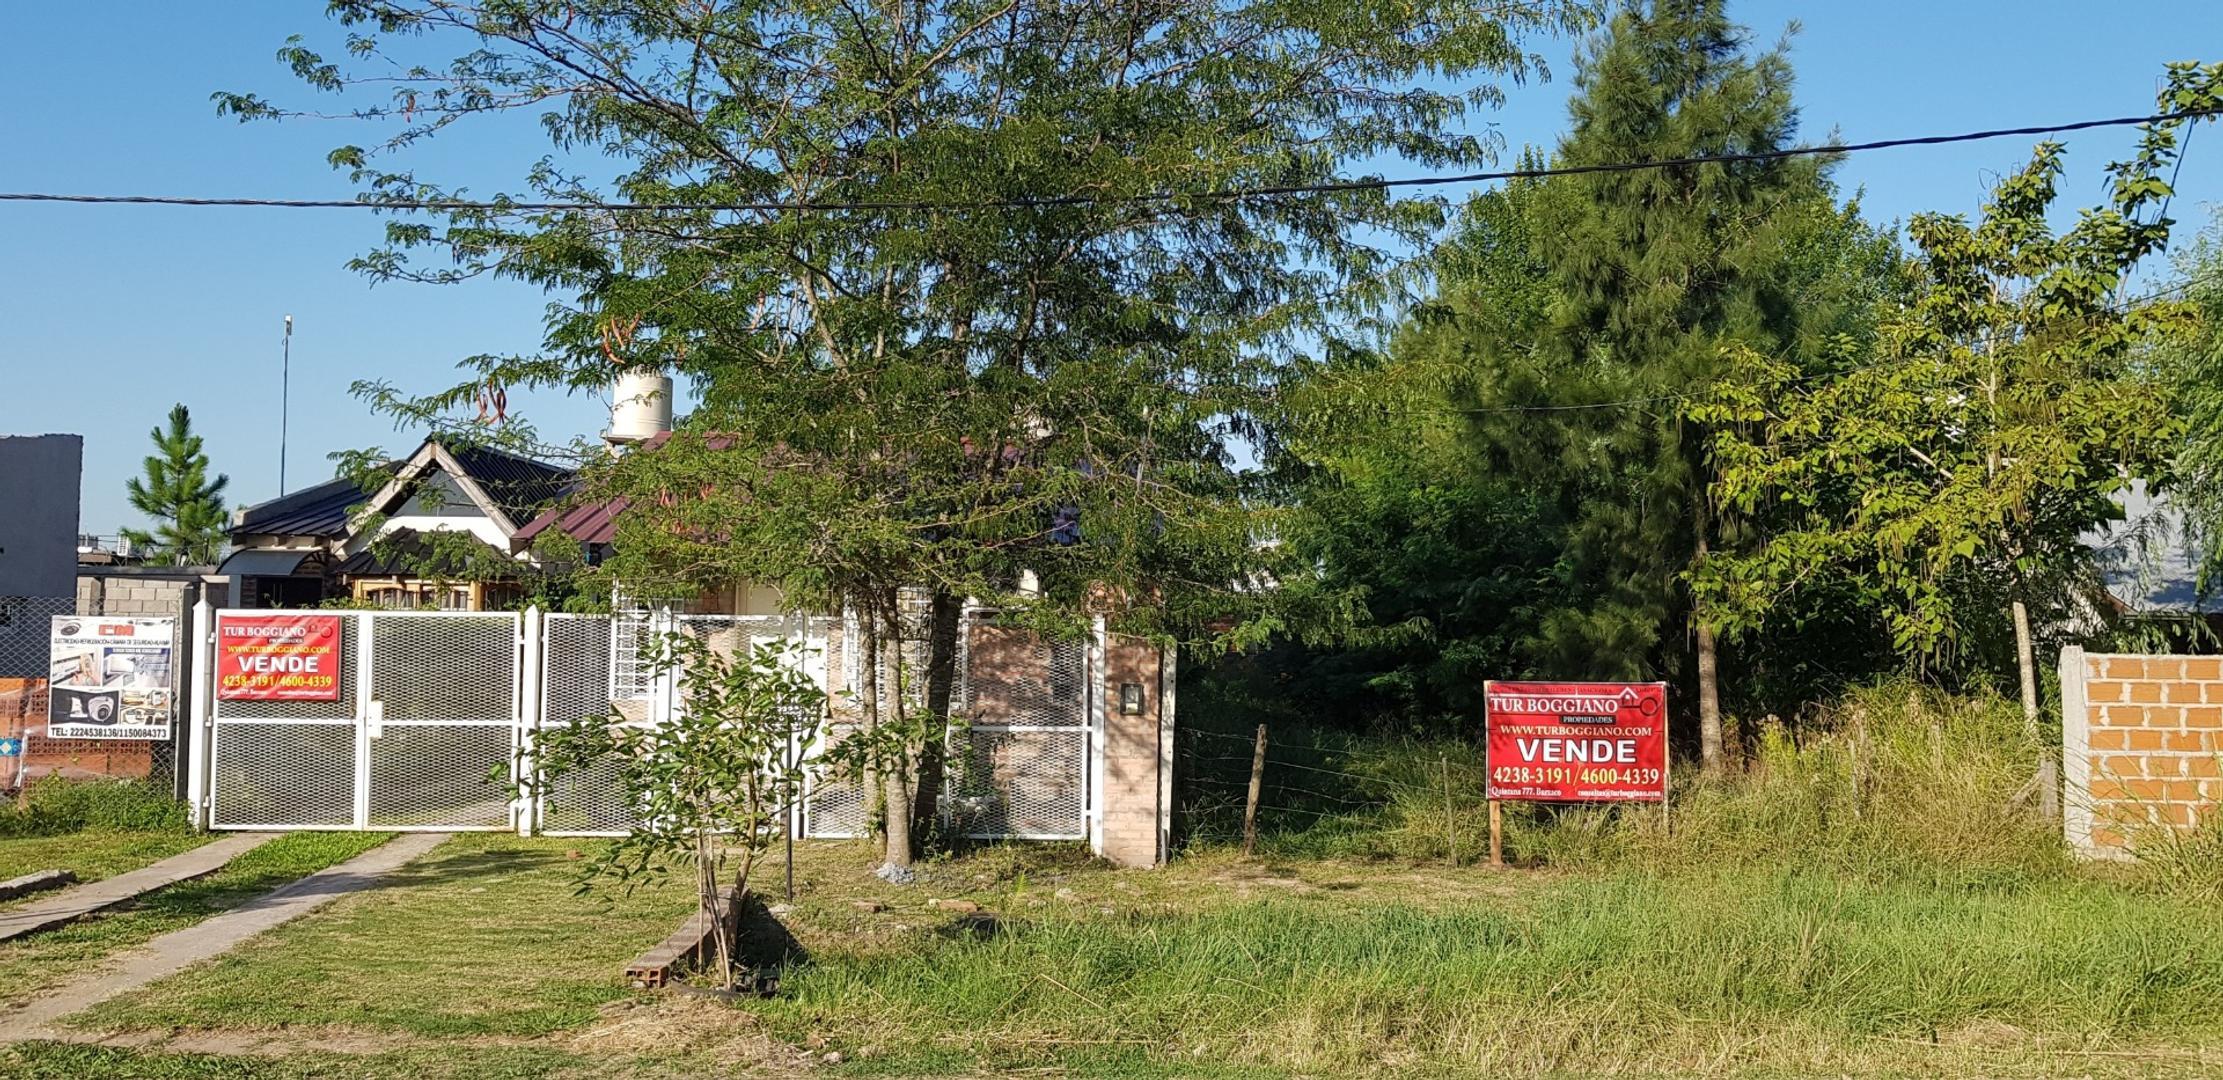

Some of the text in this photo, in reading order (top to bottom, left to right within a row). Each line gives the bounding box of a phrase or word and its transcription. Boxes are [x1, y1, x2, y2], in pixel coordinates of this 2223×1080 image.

[223, 626, 307, 637] TUR BOGGIANO
[227, 645, 330, 654] WWW.TURBOGGIANO.COM
[238, 655, 319, 673] VENDE
[223, 675, 332, 687] 4238-3191/4600-4339
[1490, 698, 1618, 714] TUR BOGGIANO
[1563, 716, 1613, 724] PROPIEDADES
[51, 727, 68, 737] TEL:
[1500, 725, 1652, 737] WWW.TURBOGGIANO.COM
[1516, 738, 1637, 763] VENDE
